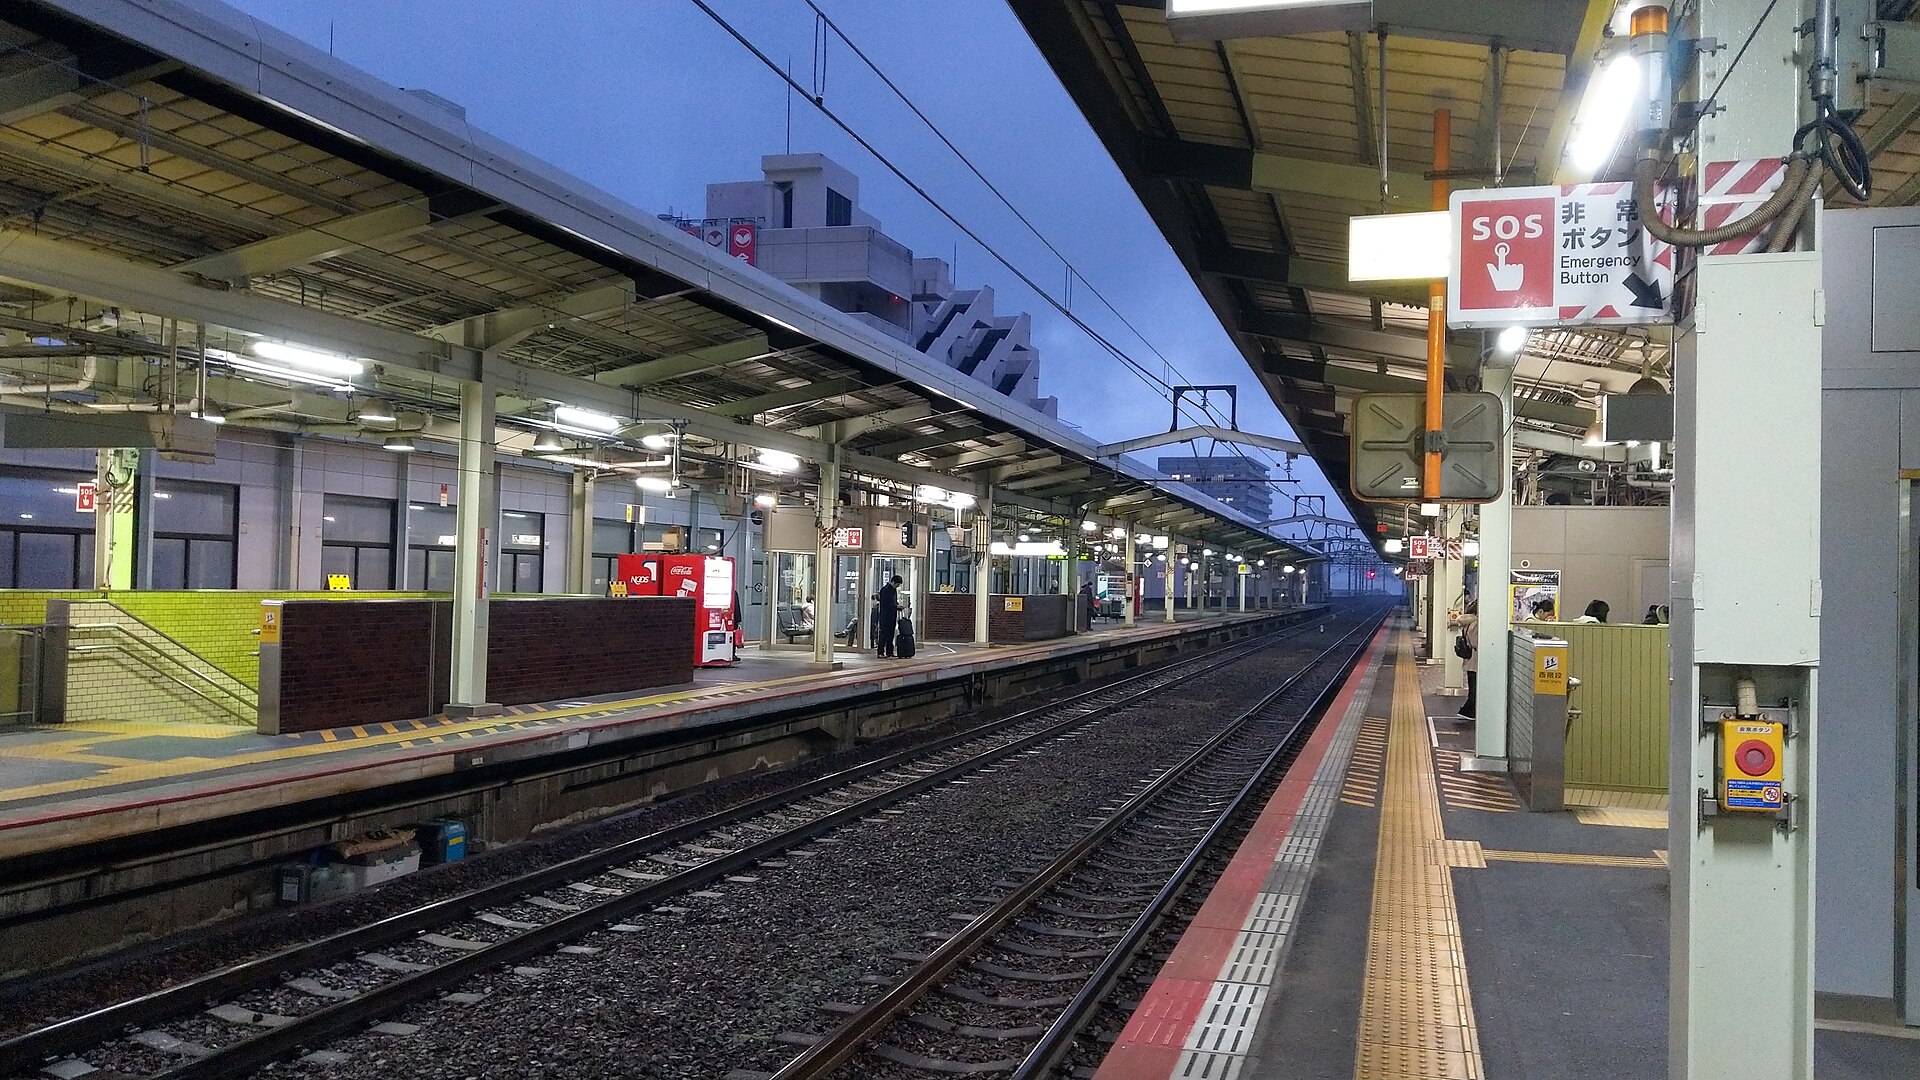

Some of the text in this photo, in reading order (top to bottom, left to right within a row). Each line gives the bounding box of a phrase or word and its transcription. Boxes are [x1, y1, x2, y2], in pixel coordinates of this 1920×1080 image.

[1472, 214, 1543, 241] SOS
[1562, 227, 1640, 250] ボタン
[1561, 255, 1641, 268] Emergency
[1561, 271, 1609, 284] Button
